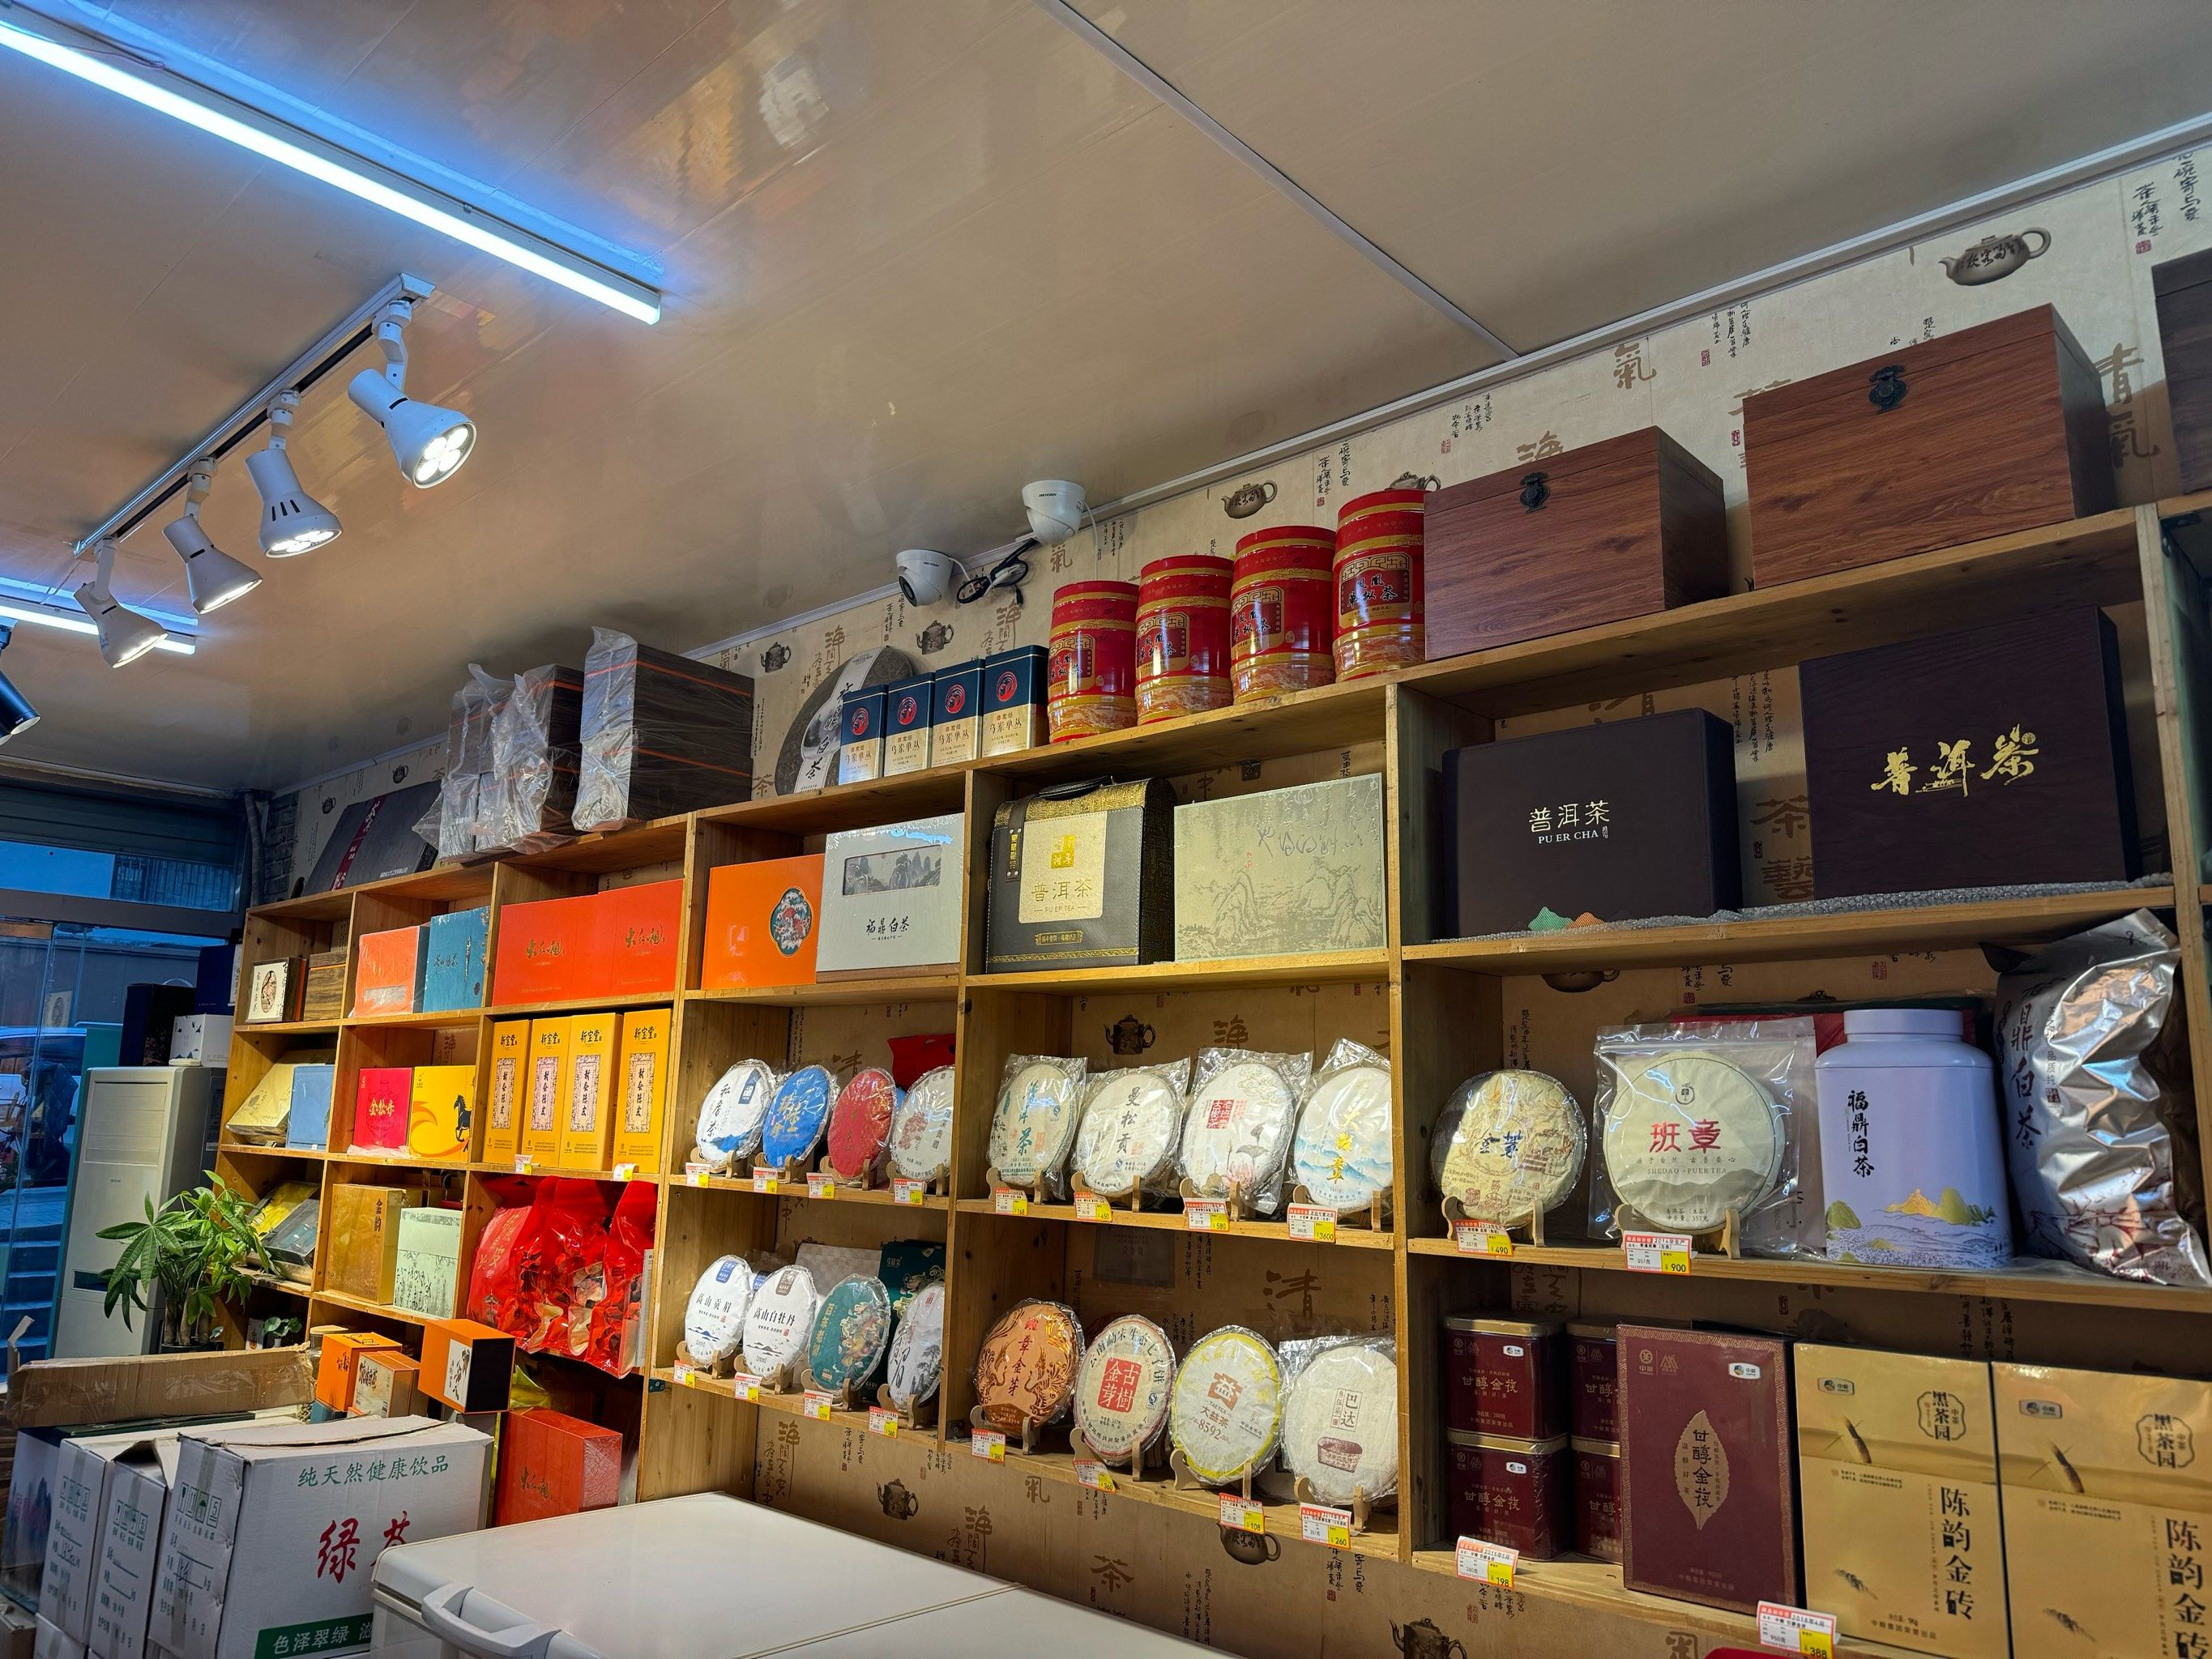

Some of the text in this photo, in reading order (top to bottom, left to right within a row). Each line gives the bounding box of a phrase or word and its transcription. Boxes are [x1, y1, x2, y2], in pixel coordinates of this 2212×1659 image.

[1871, 723, 2040, 797] 普洱茶
[1529, 800, 1610, 833] 普洱茶
[1539, 830, 1599, 844] PU ER CHA
[1031, 878, 1092, 902] 普洱茶
[866, 916, 910, 934] 福鼎白茶
[1117, 1086, 1140, 1154] 曼松贡
[1649, 1119, 1721, 1154] 班章
[1848, 1090, 1874, 1178] 福鼎白茶
[1671, 1264, 1686, 1273] 900
[754, 1307, 796, 1327] 高山白牡丹
[1462, 1375, 1518, 1393] 甘醇金茯
[1585, 1383, 1618, 1397] 甘醇
[1200, 1405, 1229, 1429] 大益茶
[1341, 1393, 1358, 1428] 巴达
[1932, 1390, 1953, 1441] 黑茶园
[1198, 1418, 1221, 1440] 8592
[2154, 1414, 2176, 1469] 黑茶园
[297, 1455, 449, 1487] 纯天然健康饮品
[1693, 1429, 1713, 1508] 甘醇金茯
[1464, 1491, 1521, 1511] 甘醇金茯
[1590, 1500, 1621, 1516] 甘醇
[1250, 1523, 1261, 1531] 108
[1335, 1537, 1347, 1546] 260
[1941, 1486, 1975, 1620] 陈韵金砖
[1090, 1555, 1134, 1593] 茶
[1497, 1576, 1510, 1588] 198
[2165, 1517, 2212, 1659] 陈韵金砖
[273, 1623, 349, 1653] 色泽翠绿
[1809, 1646, 1828, 1659] 388
